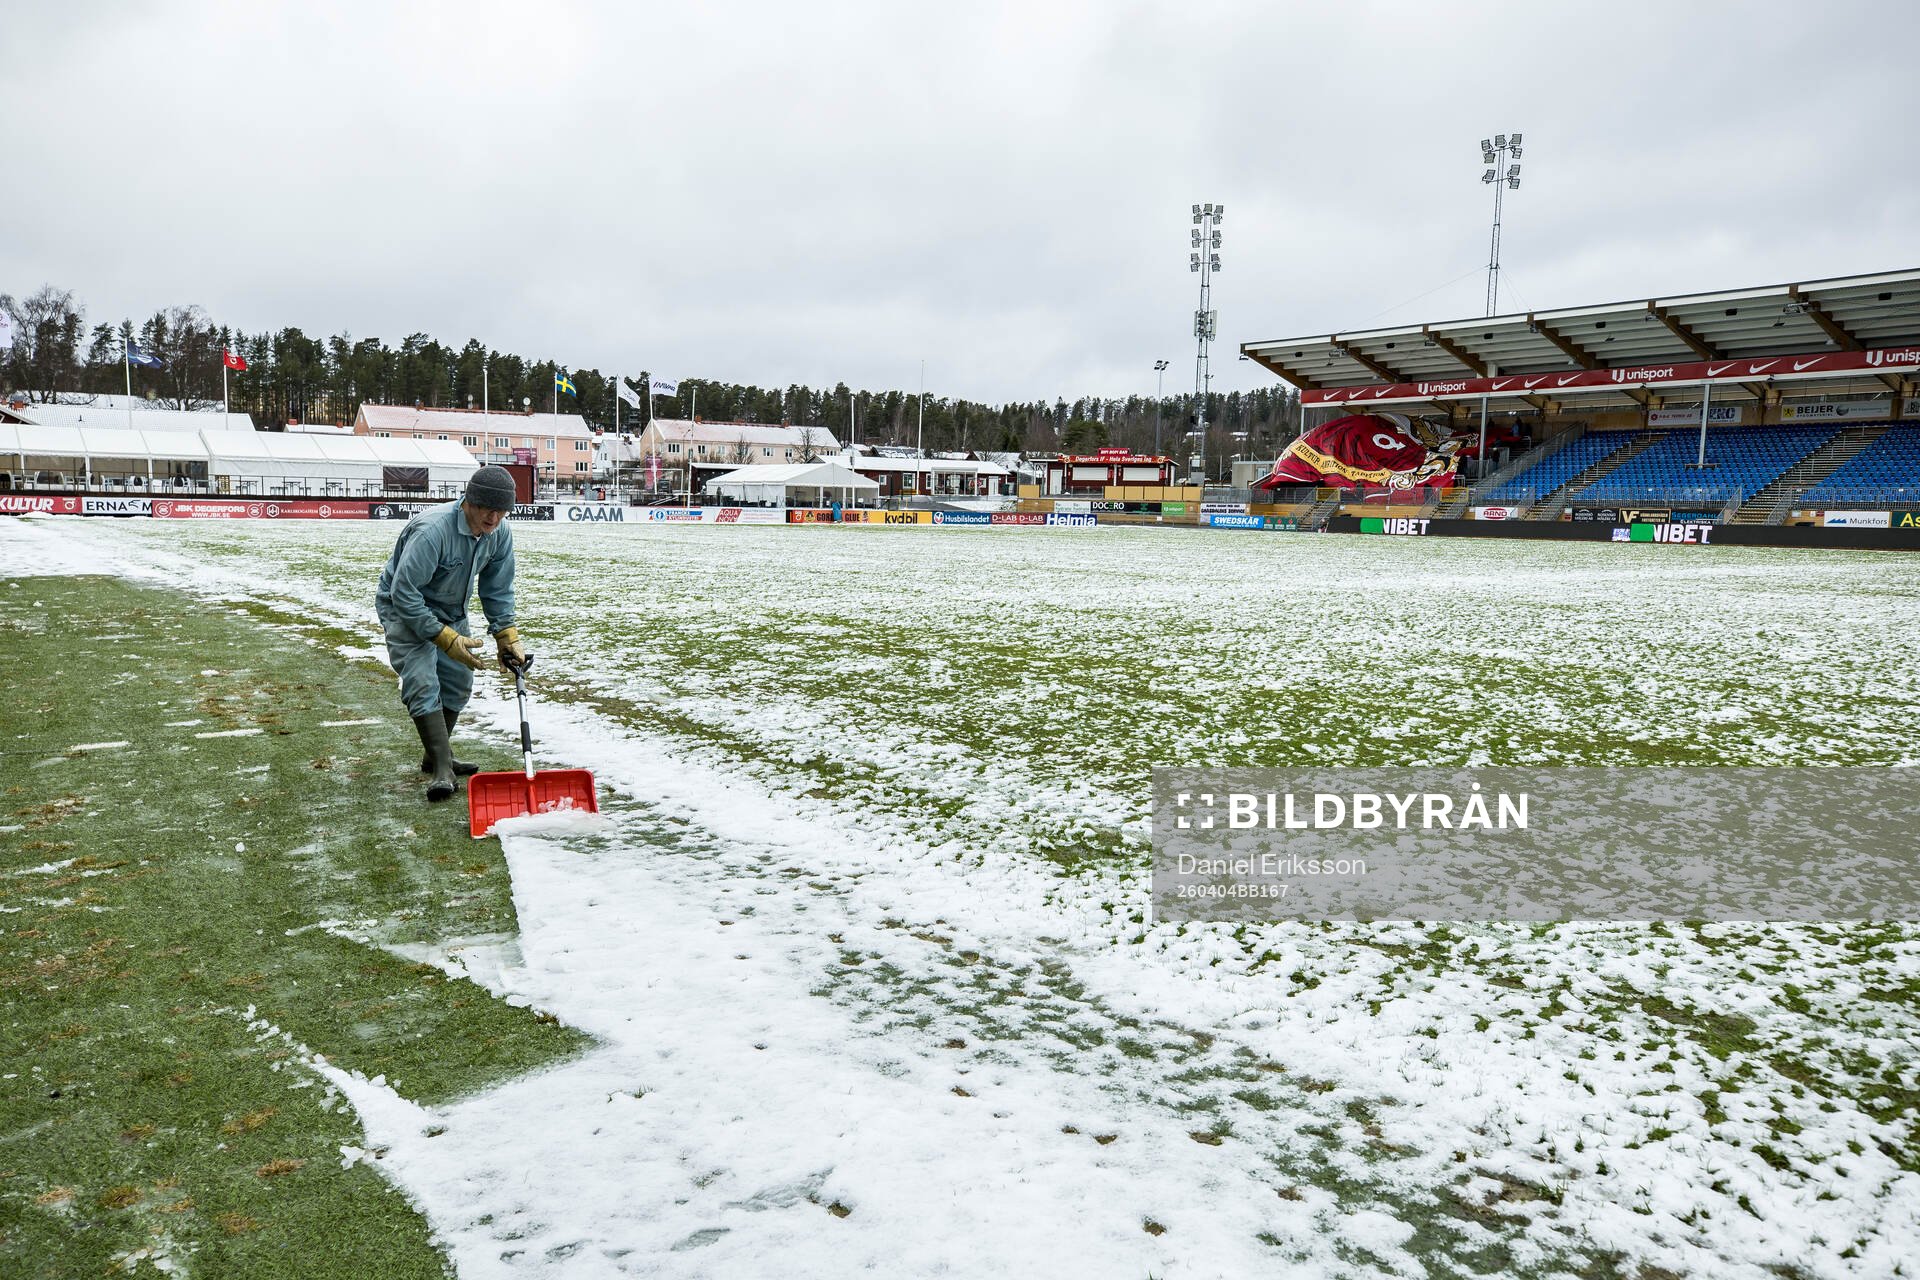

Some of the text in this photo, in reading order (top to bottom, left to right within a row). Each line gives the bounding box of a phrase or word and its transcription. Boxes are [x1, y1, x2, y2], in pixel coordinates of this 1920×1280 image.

[1627, 367, 1674, 381] unisport
[1429, 382, 1466, 393] unisport
[1797, 405, 1833, 414] BEIJER
[1075, 455, 1099, 463] Degerfors
[1296, 444, 1320, 465] KULTUR
[195, 505, 246, 513] DEGERFORS
[568, 507, 624, 522] GAAM
[845, 513, 860, 522] GLUE
[884, 512, 918, 524] kvdbil
[945, 514, 990, 523] Husbilslandet
[1046, 514, 1097, 526] Helmia
[1622, 511, 1640, 523] VF
[1900, 512, 1920, 527] As
